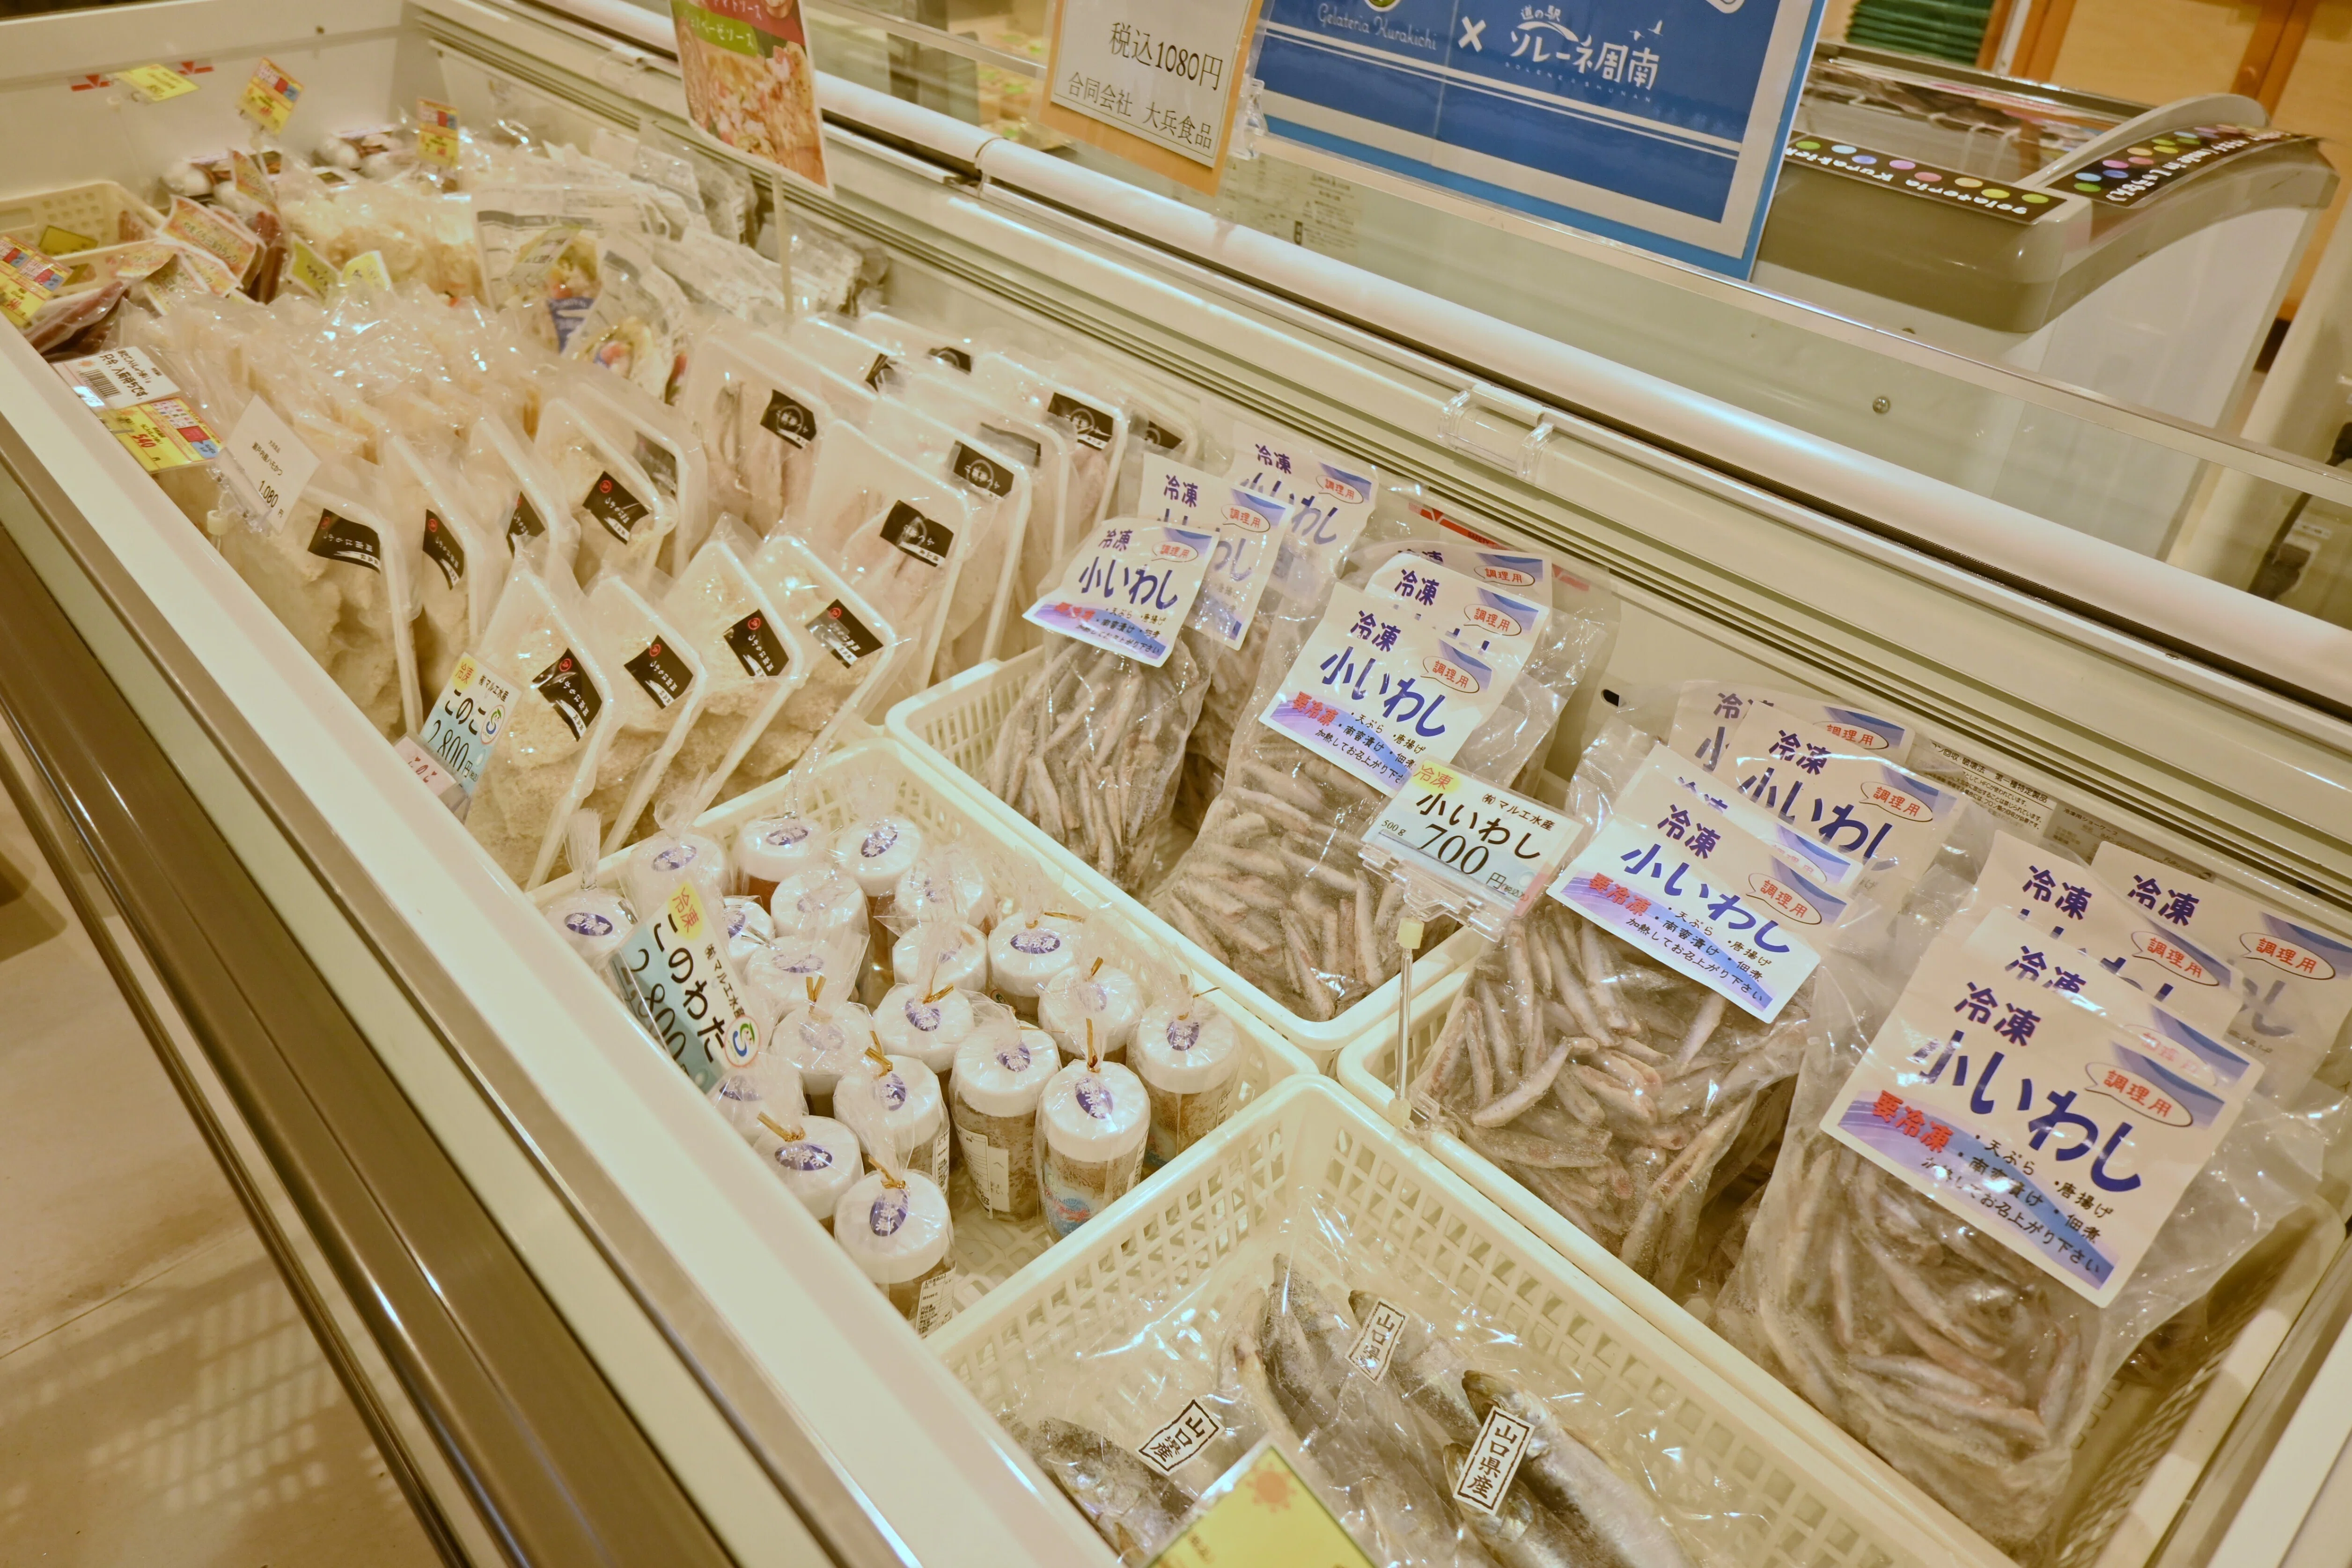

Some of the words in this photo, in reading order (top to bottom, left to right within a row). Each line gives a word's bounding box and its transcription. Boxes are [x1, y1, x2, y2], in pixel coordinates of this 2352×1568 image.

[1317, 2, 1370, 34] Gelateria
[1374, 15, 1437, 51] Kurakichi
[1521, 5, 1561, 22] 道の駅
[1110, 22, 1223, 91] 税込1080円
[1510, 30, 1660, 91] ソレーネ周南
[1068, 72, 1132, 117] 合同会社
[1143, 102, 1212, 149] 大兵食品
[1786, 147, 1894, 182] Kurakich
[1905, 179, 2027, 214] gelateria
[132, 434, 157, 448] 540
[1255, 443, 1292, 474] 冷凍
[1163, 474, 1199, 508] 冷凍
[1324, 478, 1355, 500] 調理用
[1098, 528, 1133, 552] 冷凍
[1229, 507, 1261, 530] 調理用
[1159, 544, 1190, 559] 調理用
[1078, 556, 1178, 610] 小いわし
[1394, 568, 1440, 606] 冷凍
[1485, 567, 1523, 584] 調理用
[1350, 610, 1401, 653] 冷凍
[1473, 607, 1511, 632] 調理用
[455, 661, 474, 684] 冷凍
[1320, 645, 1446, 738] 小いわし
[1432, 660, 1469, 689] 調理用
[444, 688, 486, 736] このこ
[1291, 690, 1339, 727] 要冷凍
[427, 719, 469, 772] 2800
[1315, 729, 1404, 785] 加熱してお召上がり下さ
[1769, 729, 1832, 775] 冷凍
[1826, 723, 1874, 747] 調理用
[1412, 764, 1454, 790] 冷凍
[1994, 773, 2048, 803] 第一種特定製品
[1872, 785, 1922, 818] 調理用
[1415, 793, 1541, 859] 小いわし
[1657, 804, 1721, 860] 冷凍
[1419, 823, 1490, 875] 700
[1486, 872, 1507, 893] 円
[672, 887, 699, 934] 冷凍
[1588, 871, 1652, 917] 要冷凍
[1620, 843, 1791, 953] 小いわし
[1760, 880, 1809, 919] 調理用
[2021, 865, 2092, 921] 冷凍
[2127, 875, 2200, 926] 冷凍
[1624, 917, 1764, 1002] 加熱してお召上がり下さい
[2146, 936, 2203, 979] 調理用
[2256, 938, 2317, 973] 調理用
[654, 913, 726, 1063] このわた
[1954, 981, 2042, 1047] 冷凍
[1906, 1030, 2142, 1193] 小いわし
[2102, 1068, 2173, 1119] 調理用
[1872, 1090, 1955, 1154] 要冷凍
[1154, 1415, 1206, 1463] 山口県産
[1466, 1424, 1519, 1499] 山口県産
